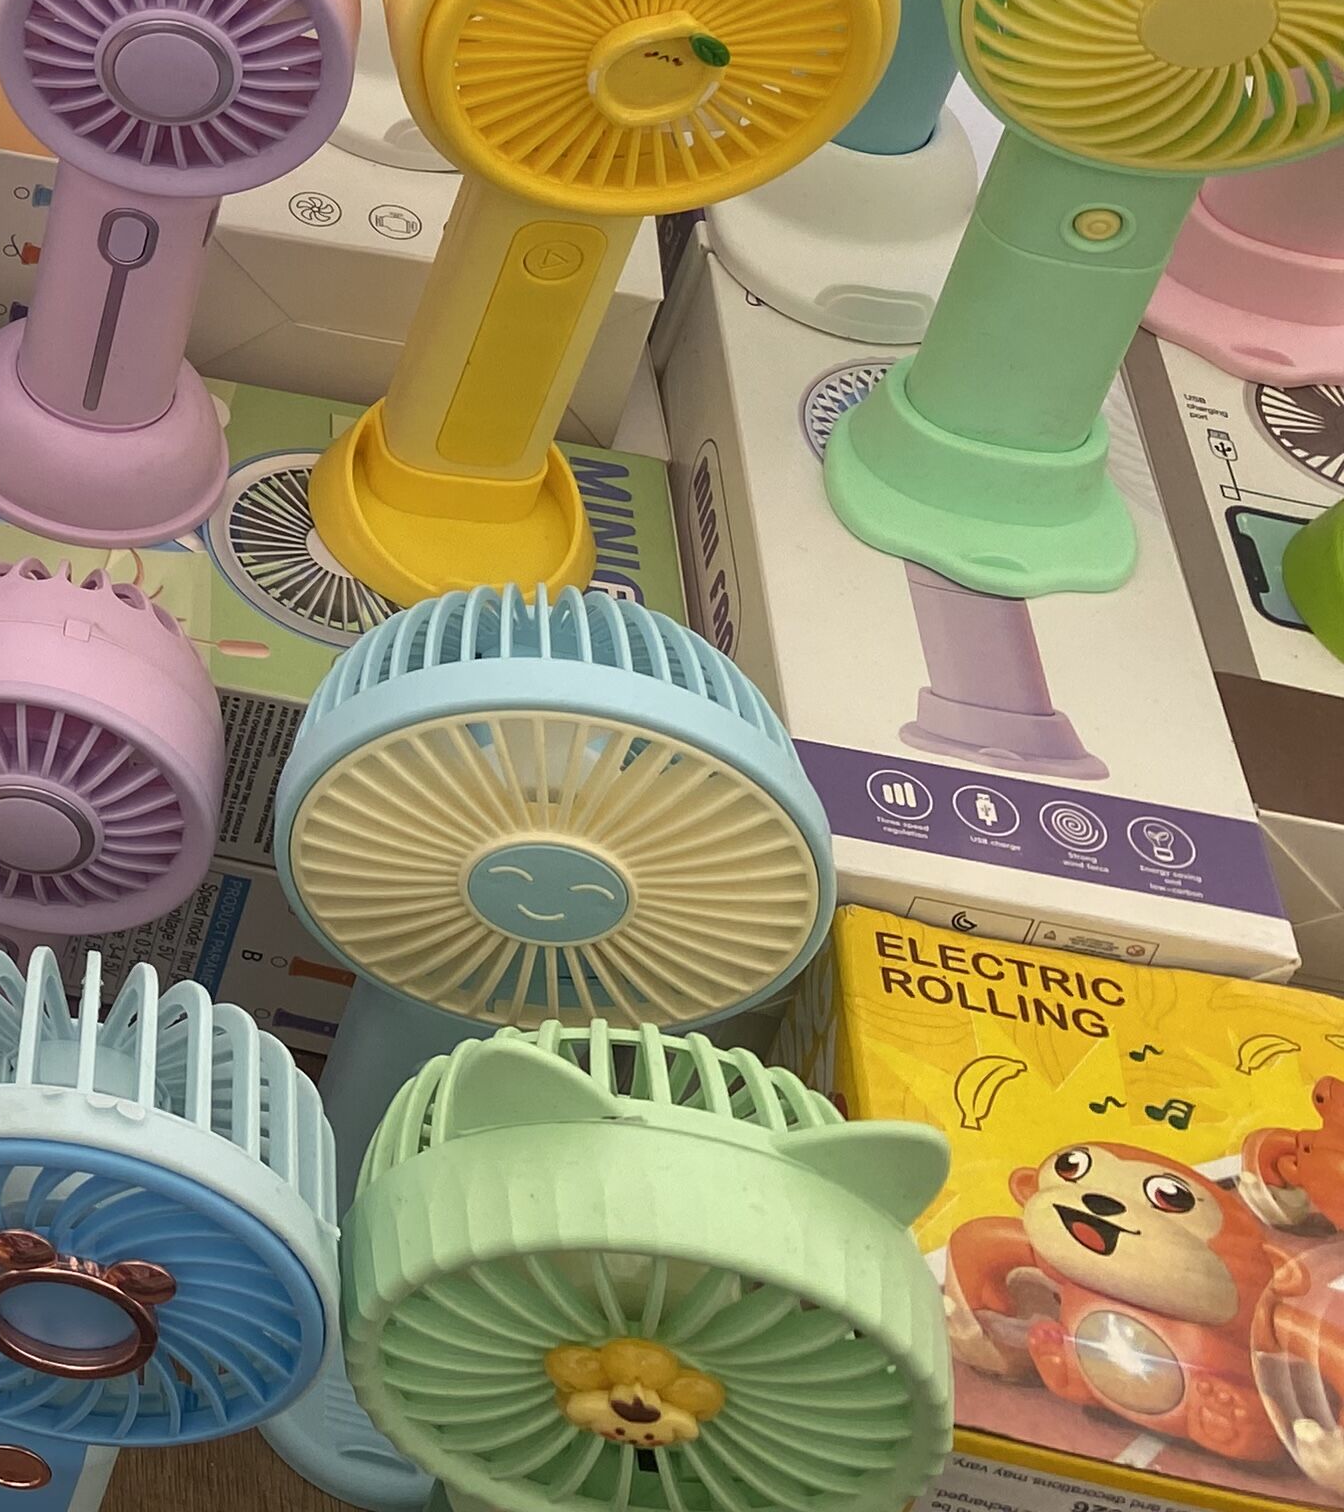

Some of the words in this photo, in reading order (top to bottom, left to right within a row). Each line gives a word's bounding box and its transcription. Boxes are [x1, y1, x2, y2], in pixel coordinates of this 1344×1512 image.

[192, 881, 218, 917] Speed
[213, 878, 242, 936] PRODUCT
[177, 949, 198, 973] third
[875, 930, 1127, 1008] ELECTRIC
[879, 965, 1112, 1038] ROLLING
[951, 1455, 990, 1474] vary.
[994, 1468, 1029, 1483] may
